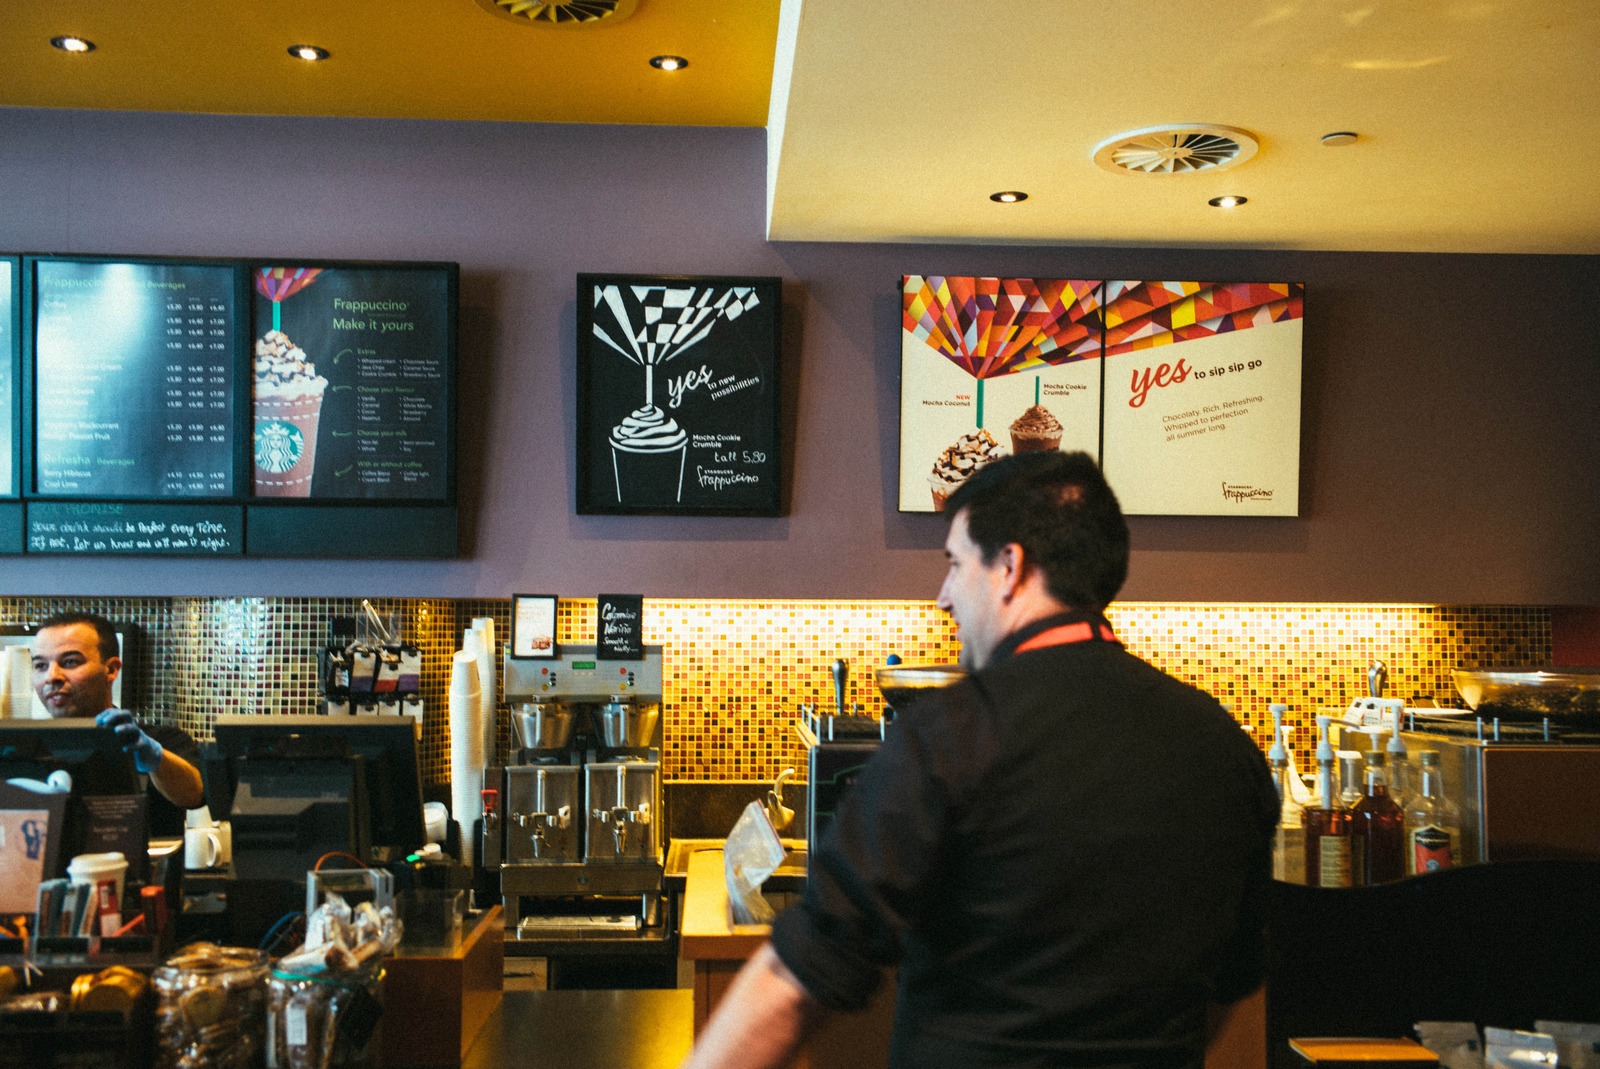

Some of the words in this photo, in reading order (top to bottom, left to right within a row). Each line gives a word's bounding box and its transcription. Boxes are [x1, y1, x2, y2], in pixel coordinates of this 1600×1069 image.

[332, 318, 366, 330] Make
[369, 318, 377, 330] it
[380, 320, 414, 334] yours
[667, 364, 713, 409] yes
[707, 381, 718, 391] to
[719, 374, 736, 387] new
[710, 376, 760, 402] possibilities
[1128, 358, 1192, 408] yes
[1194, 370, 1206, 380] to
[1209, 366, 1226, 377] sip
[1228, 362, 1245, 373] sip
[1248, 359, 1262, 370] go
[1164, 418, 1200, 432] Whipped
[1200, 416, 1209, 425] to
[1210, 408, 1249, 422] perfection
[716, 434, 742, 442] Cookie
[1166, 431, 1176, 442] all
[1176, 428, 1206, 440] summer
[714, 450, 738, 462] tall
